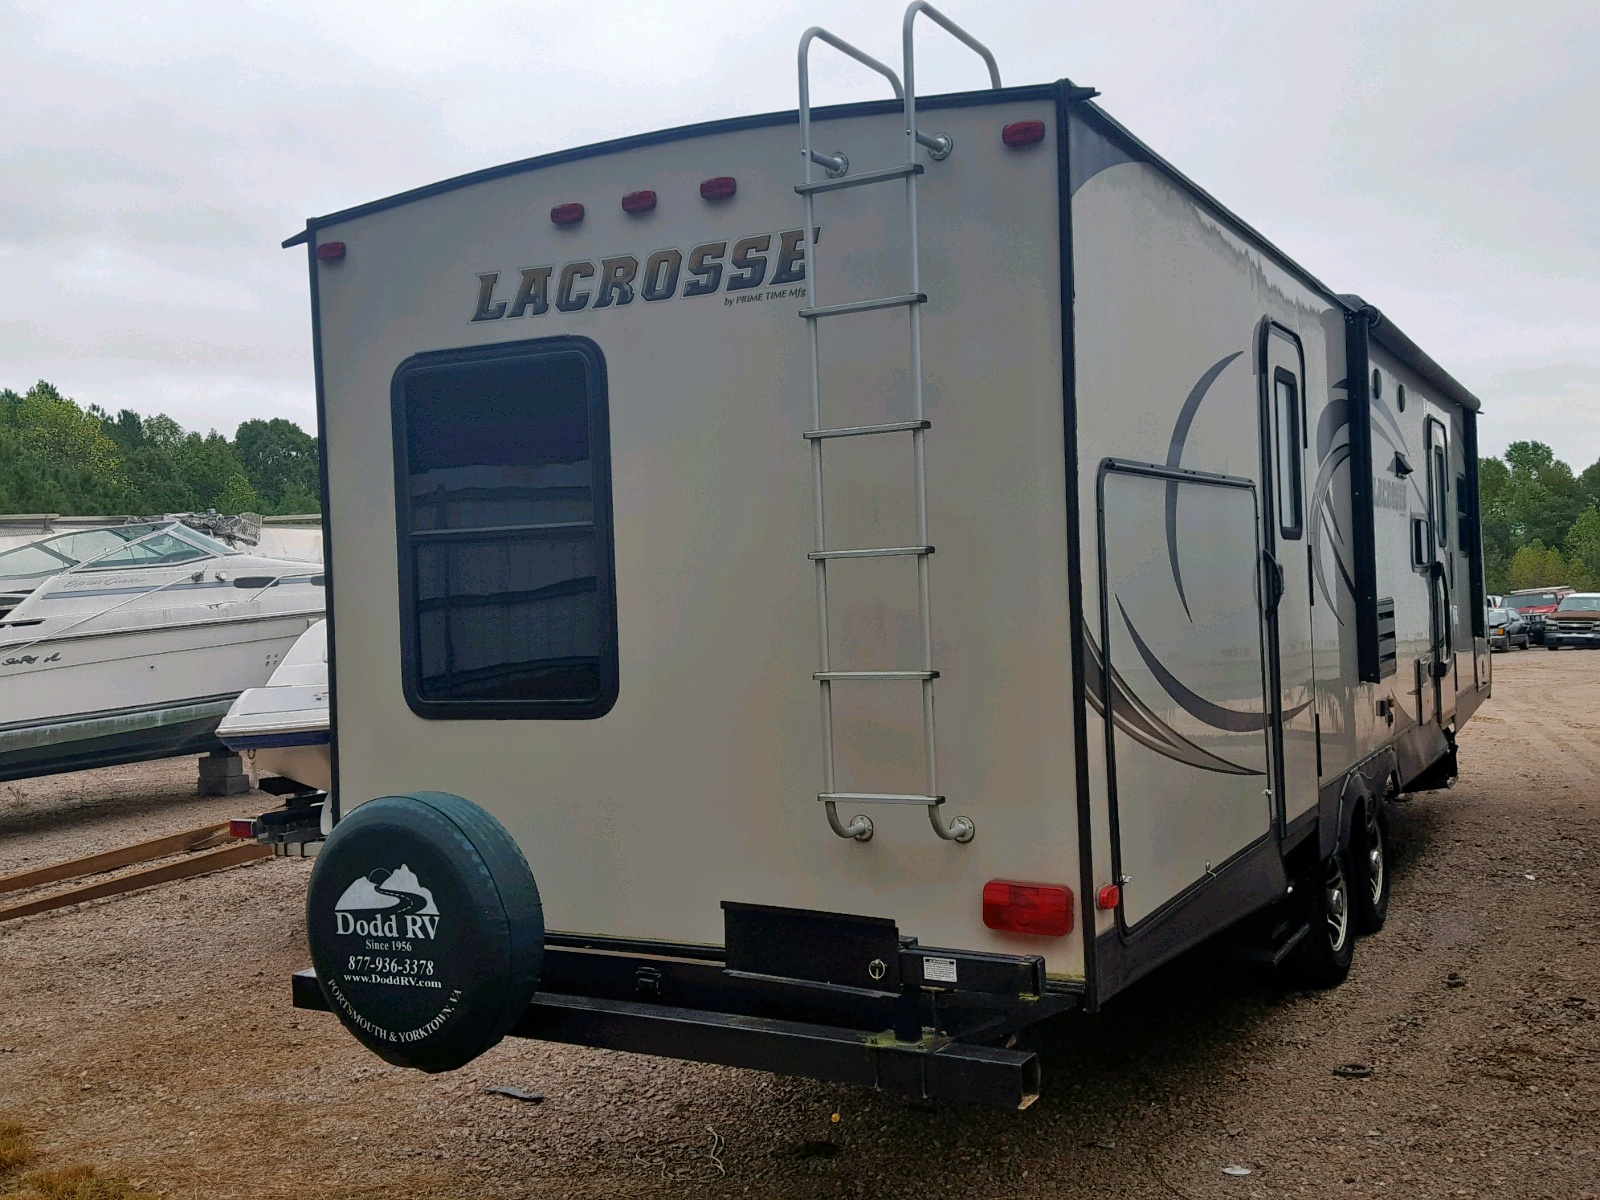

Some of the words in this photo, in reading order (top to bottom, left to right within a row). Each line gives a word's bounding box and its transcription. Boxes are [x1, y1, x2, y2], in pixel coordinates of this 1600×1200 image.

[468, 226, 822, 323] LACROSSE
[724, 298, 734, 307] by
[736, 293, 763, 304] PRIME
[765, 290, 787, 300] TIME
[335, 912, 399, 937] Dodd
[405, 915, 440, 940] RV
[366, 939, 389, 951] Since
[392, 941, 412, 952] 1956
[348, 955, 434, 976] 877-936-3378
[343, 974, 442, 989] www.DoddRV.com
[327, 978, 387, 1040] PORTSMOUTH
[388, 1031, 398, 1042] &
[398, 1005, 455, 1043] YORKTOWN,
[449, 988, 462, 1004] VA
